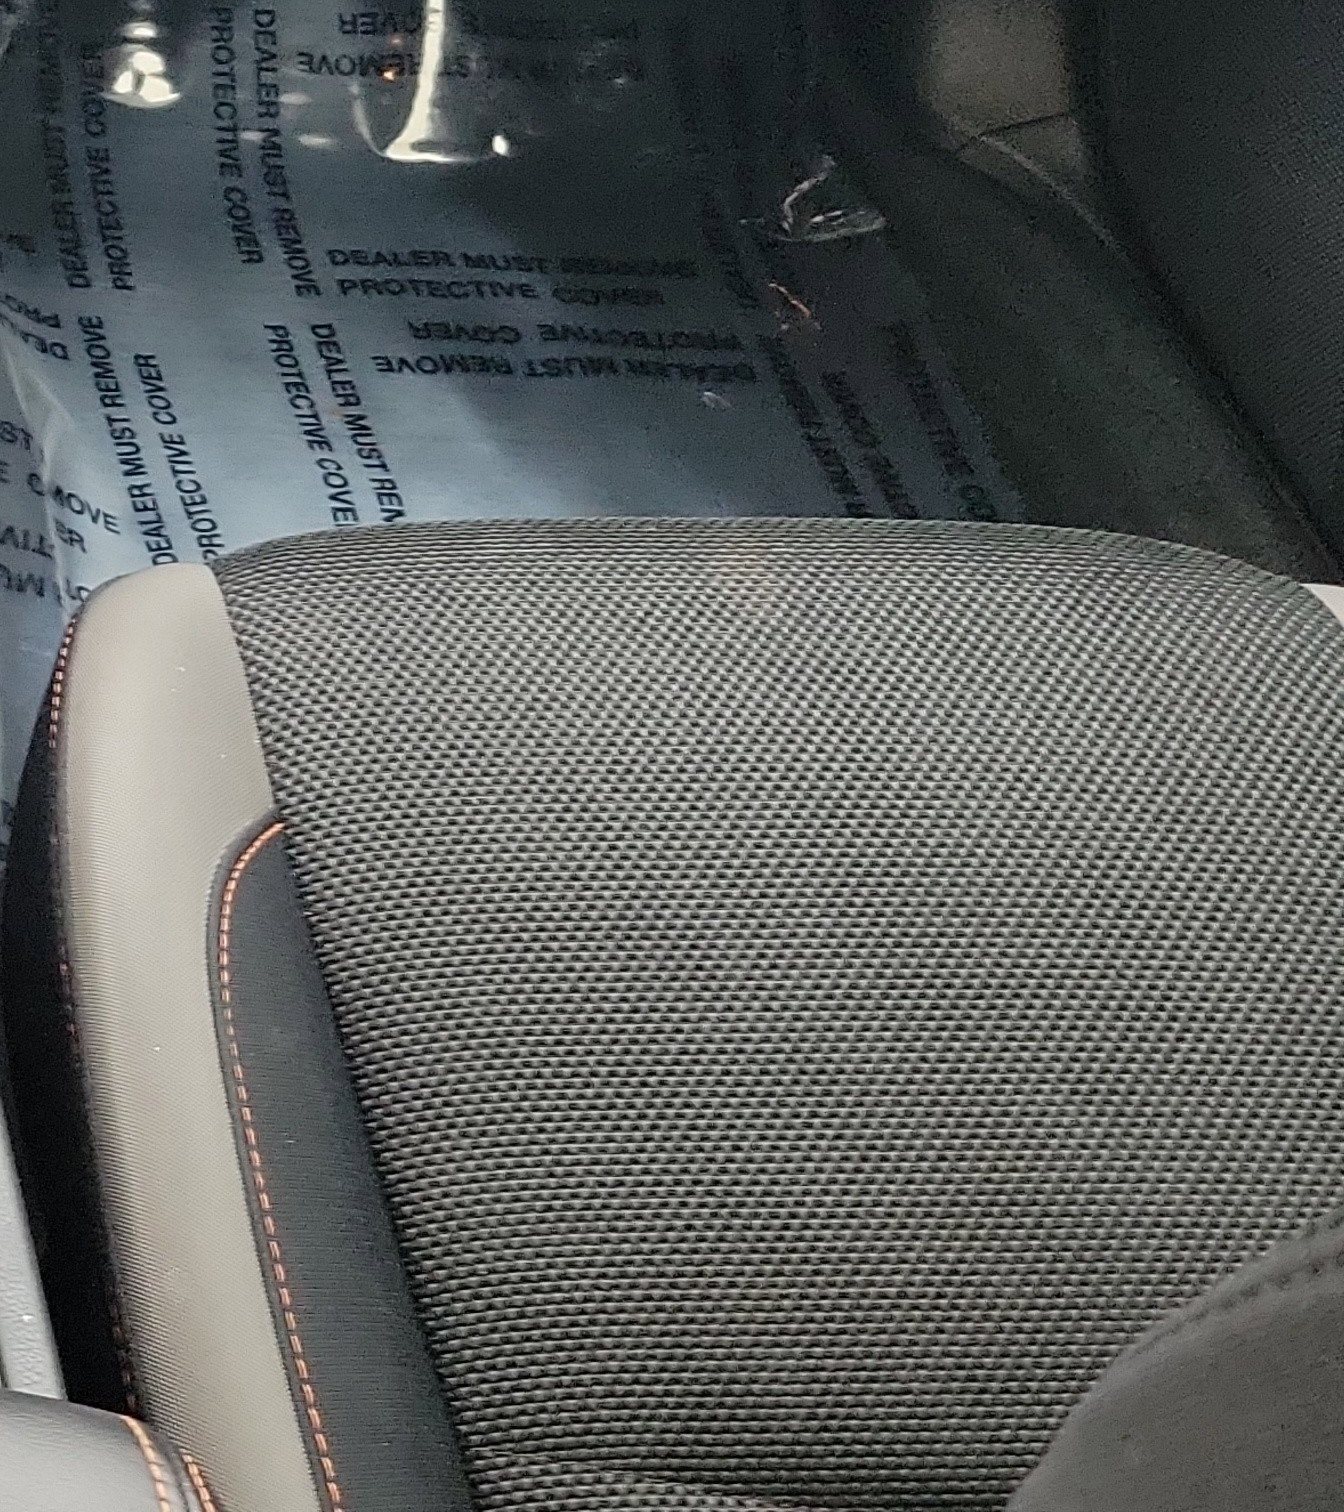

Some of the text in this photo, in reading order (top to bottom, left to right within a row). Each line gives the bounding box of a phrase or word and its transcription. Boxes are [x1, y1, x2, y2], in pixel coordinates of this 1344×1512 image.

[254, 9, 321, 297] DEALER MUST REMOVE
[223, 186, 264, 264] COVER
[326, 248, 456, 269] DEALER
[459, 251, 549, 275] MUST
[336, 277, 541, 300] PROTECTIVE
[133, 352, 177, 427] COVER
[310, 322, 362, 407] DEALER
[343, 412, 390, 472] MUST
[370, 353, 513, 376] REMOVE
[78, 314, 179, 566] DEALER MUST REMOVE
[263, 323, 359, 527] PROTECTIVE COVE
